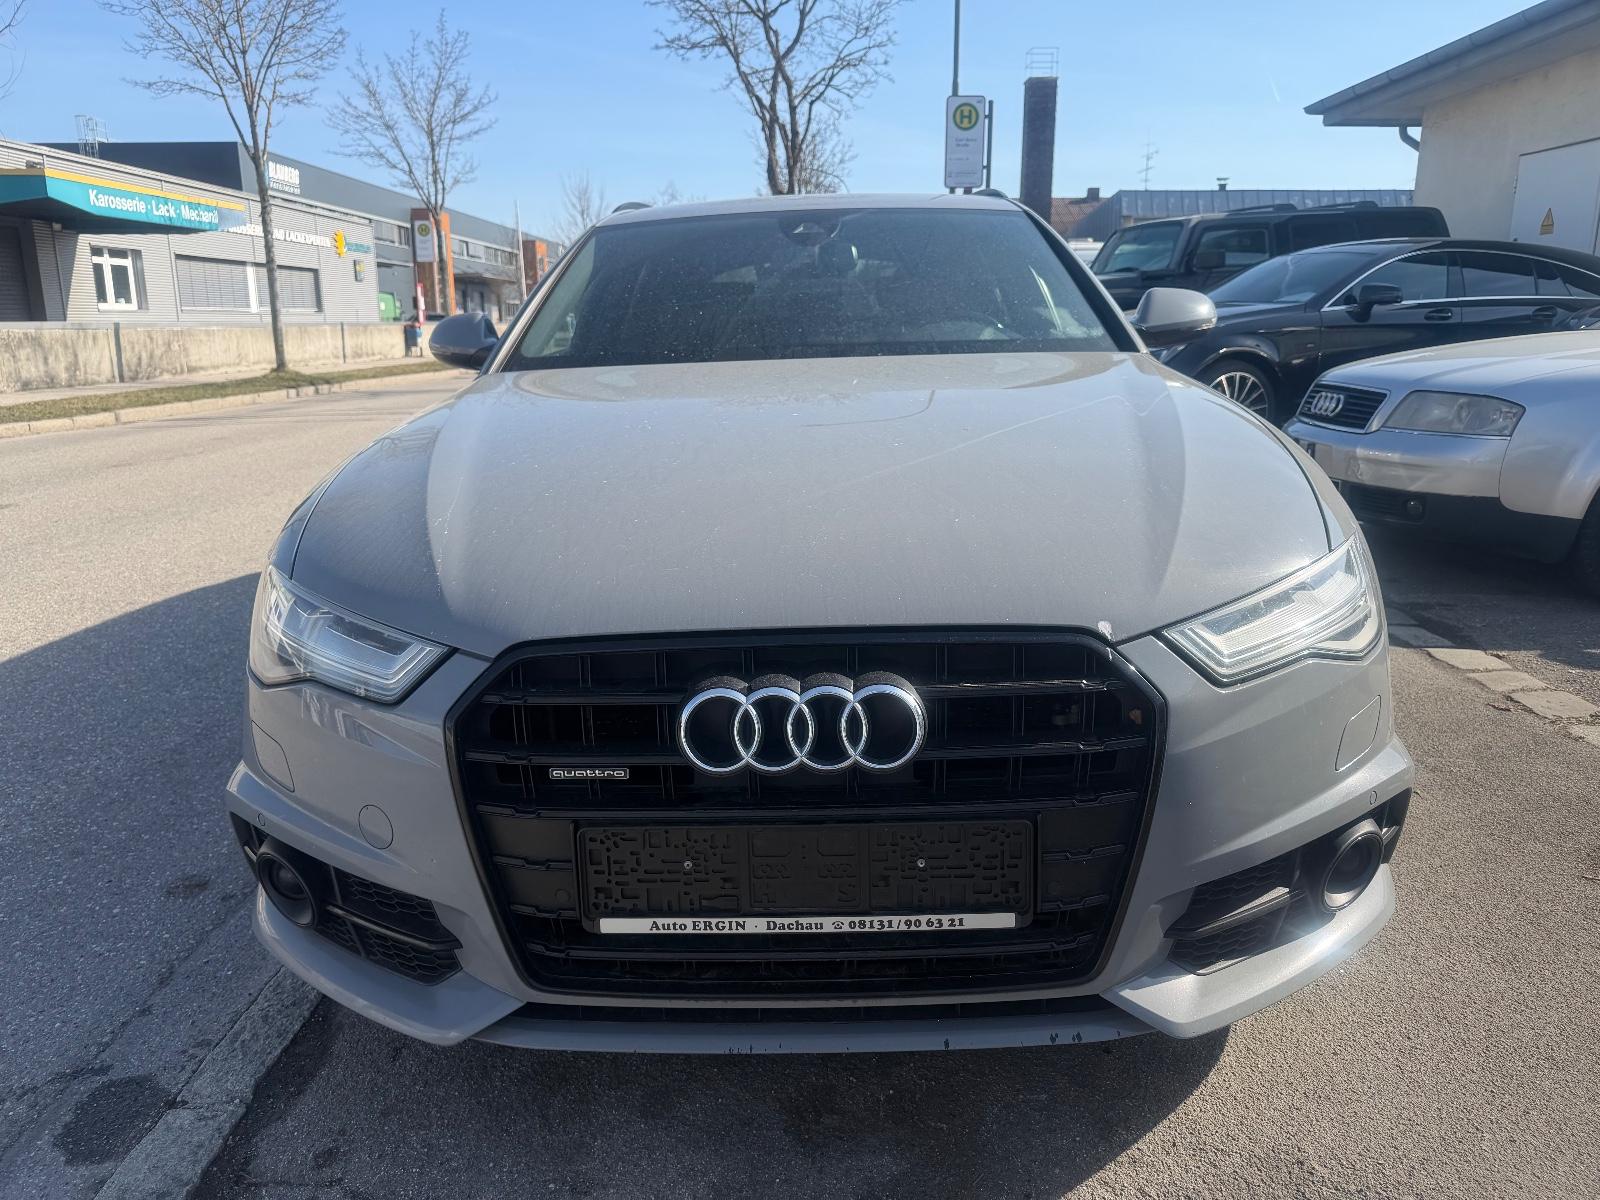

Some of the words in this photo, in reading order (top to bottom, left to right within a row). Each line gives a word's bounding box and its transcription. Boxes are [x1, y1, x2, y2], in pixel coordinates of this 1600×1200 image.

[960, 109, 972, 125] H
[88, 189, 146, 213] Karosserie
[152, 200, 176, 217] Lack
[553, 769, 625, 779] quattro
[649, 920, 687, 931] Auto
[691, 920, 746, 931] ERGIN
[765, 920, 824, 931] Dachau
[925, 917, 943, 928] 63
[947, 917, 965, 927] 21
